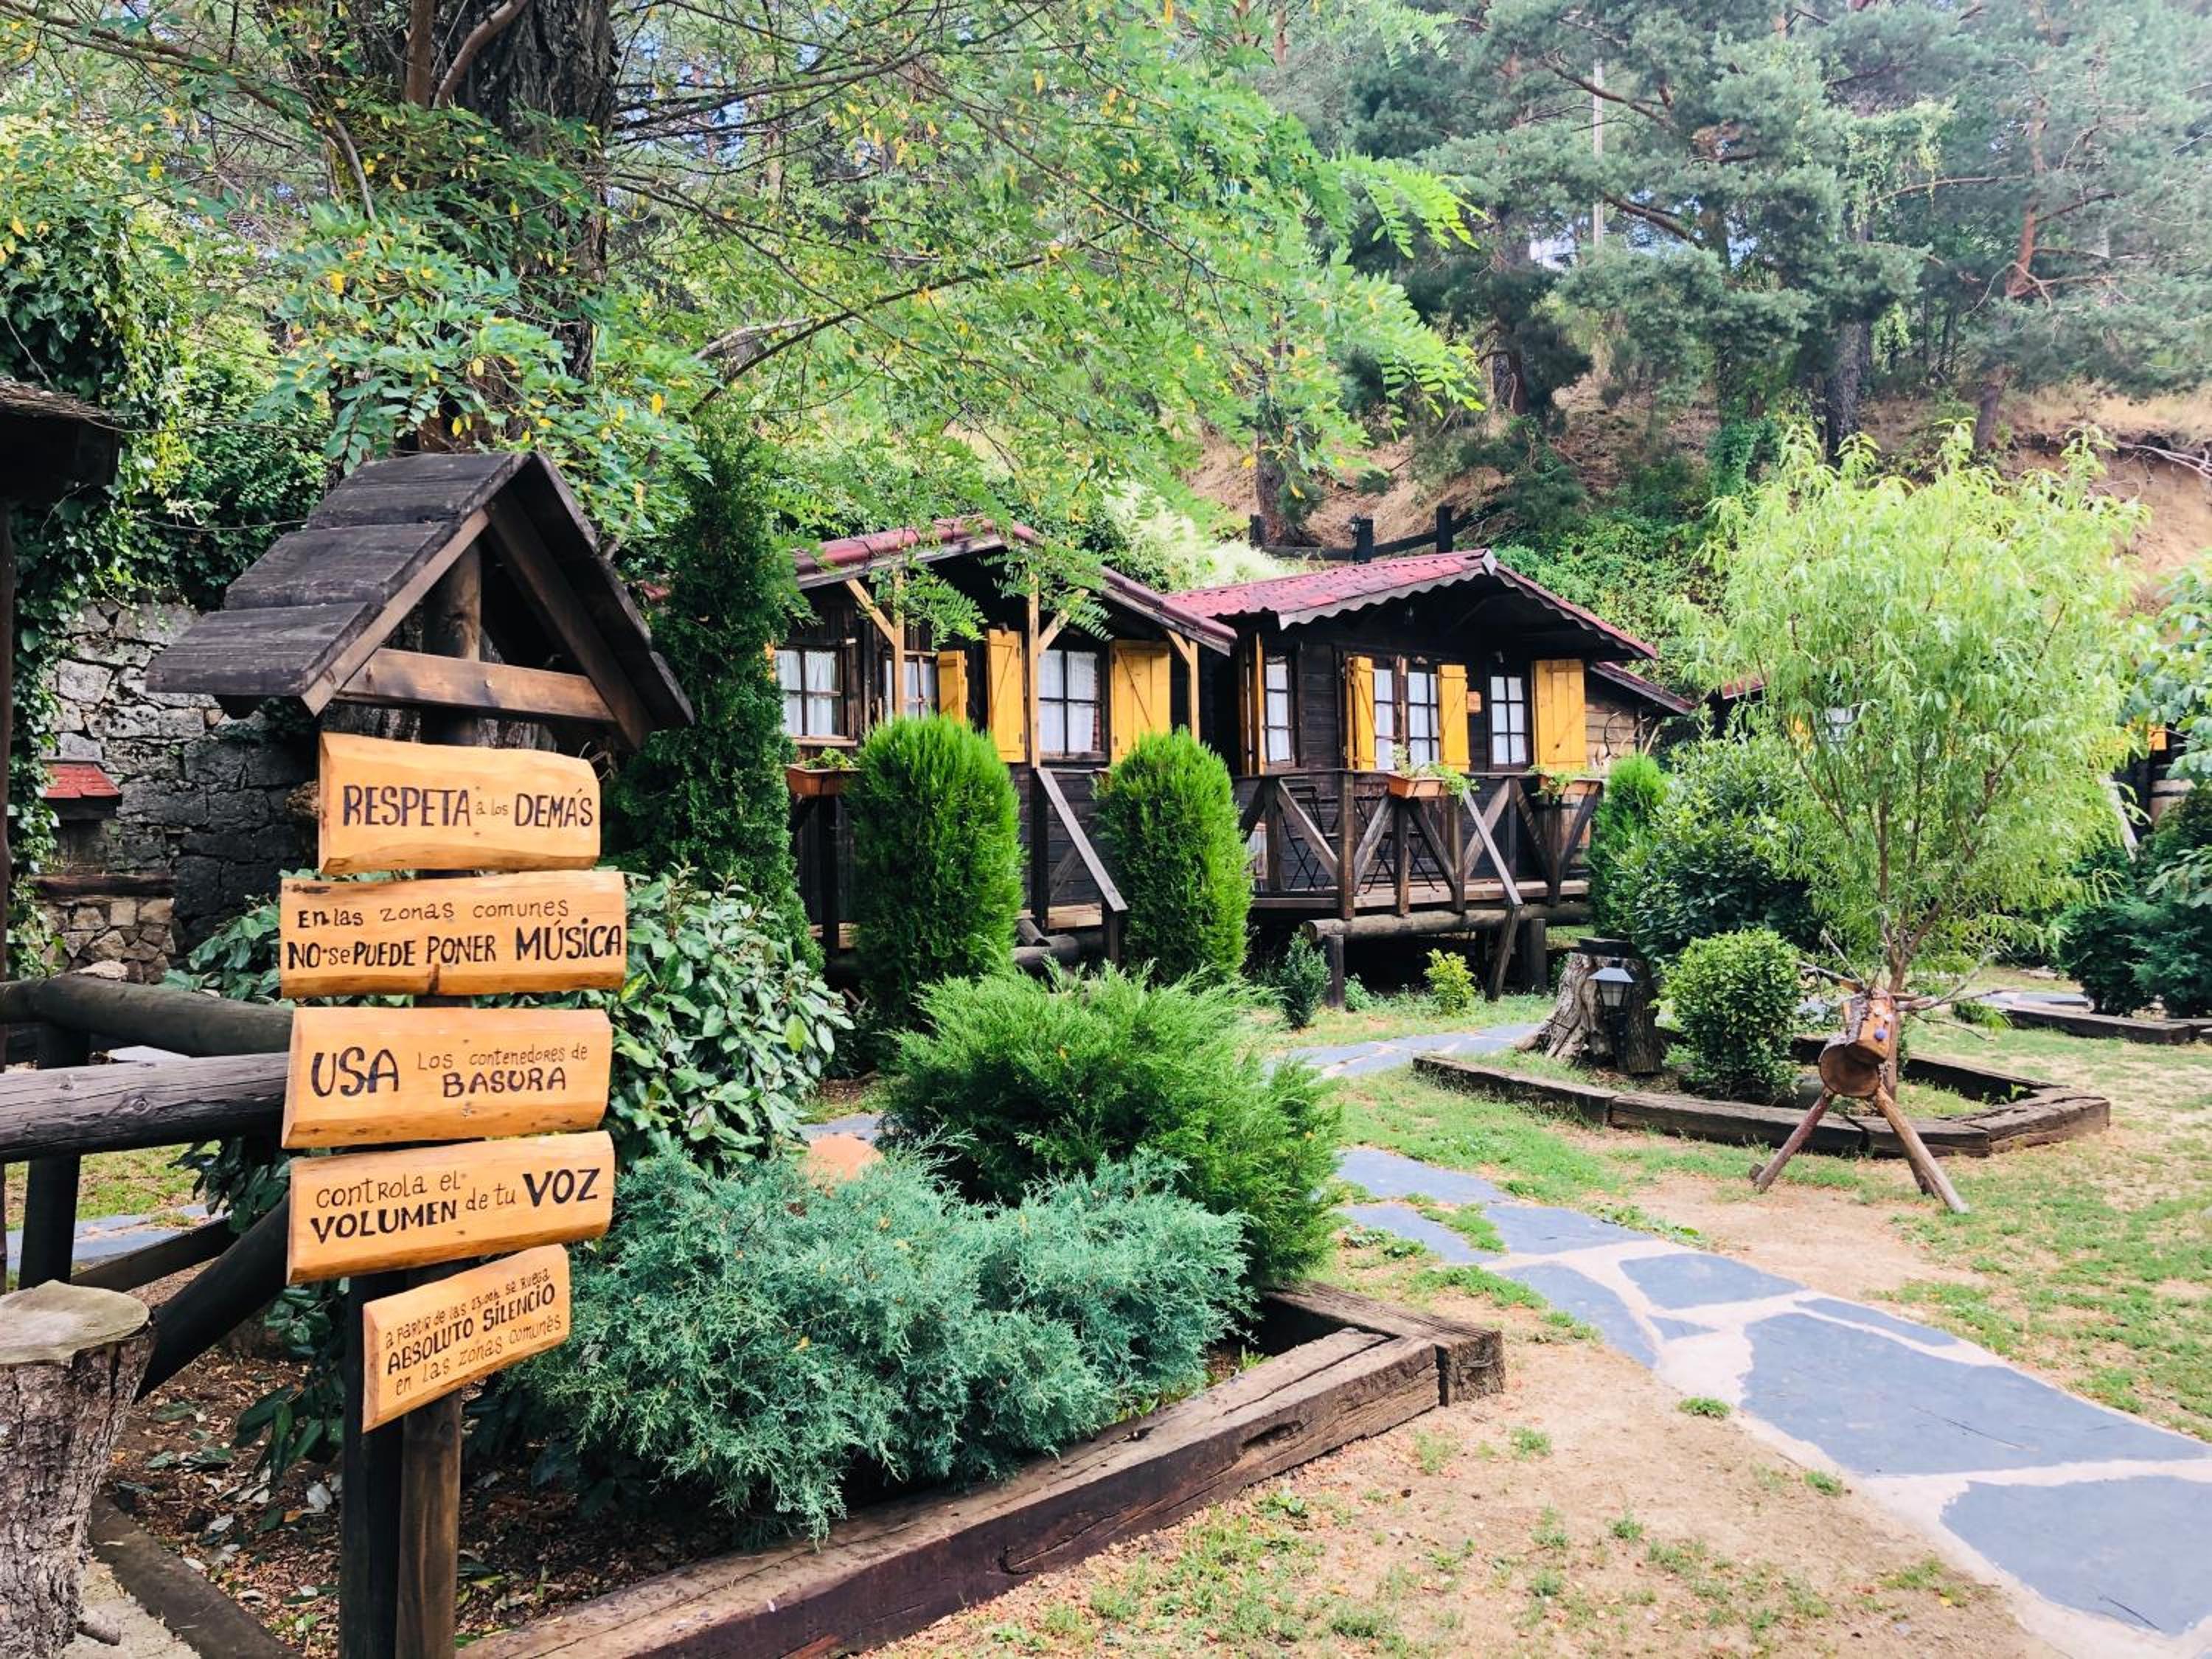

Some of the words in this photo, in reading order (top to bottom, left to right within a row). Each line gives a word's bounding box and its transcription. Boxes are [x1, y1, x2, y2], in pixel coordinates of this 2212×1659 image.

[343, 785, 470, 827] RESPETA
[476, 801, 487, 815] a
[490, 797, 508, 816] los
[515, 789, 593, 828] DEMÁS
[380, 899, 454, 922] zonas
[473, 899, 568, 918] comunes
[353, 939, 415, 967] PUEDE
[426, 935, 495, 964] PONER
[570, 1043, 588, 1062] de
[310, 1046, 399, 1097] USA
[442, 1066, 566, 1098] BASURA
[440, 1170, 461, 1192] el
[310, 1200, 457, 1245] VOLUMEN
[465, 1192, 488, 1211] de
[493, 1186, 516, 1206] tu
[522, 1168, 601, 1208] VOZ
[434, 1309, 445, 1326] de
[387, 1317, 474, 1376] ABSOLUTO
[395, 1377, 411, 1397] en
[422, 1358, 451, 1383] las
[459, 1335, 503, 1368] zonas
[509, 1314, 562, 1346] comunes
